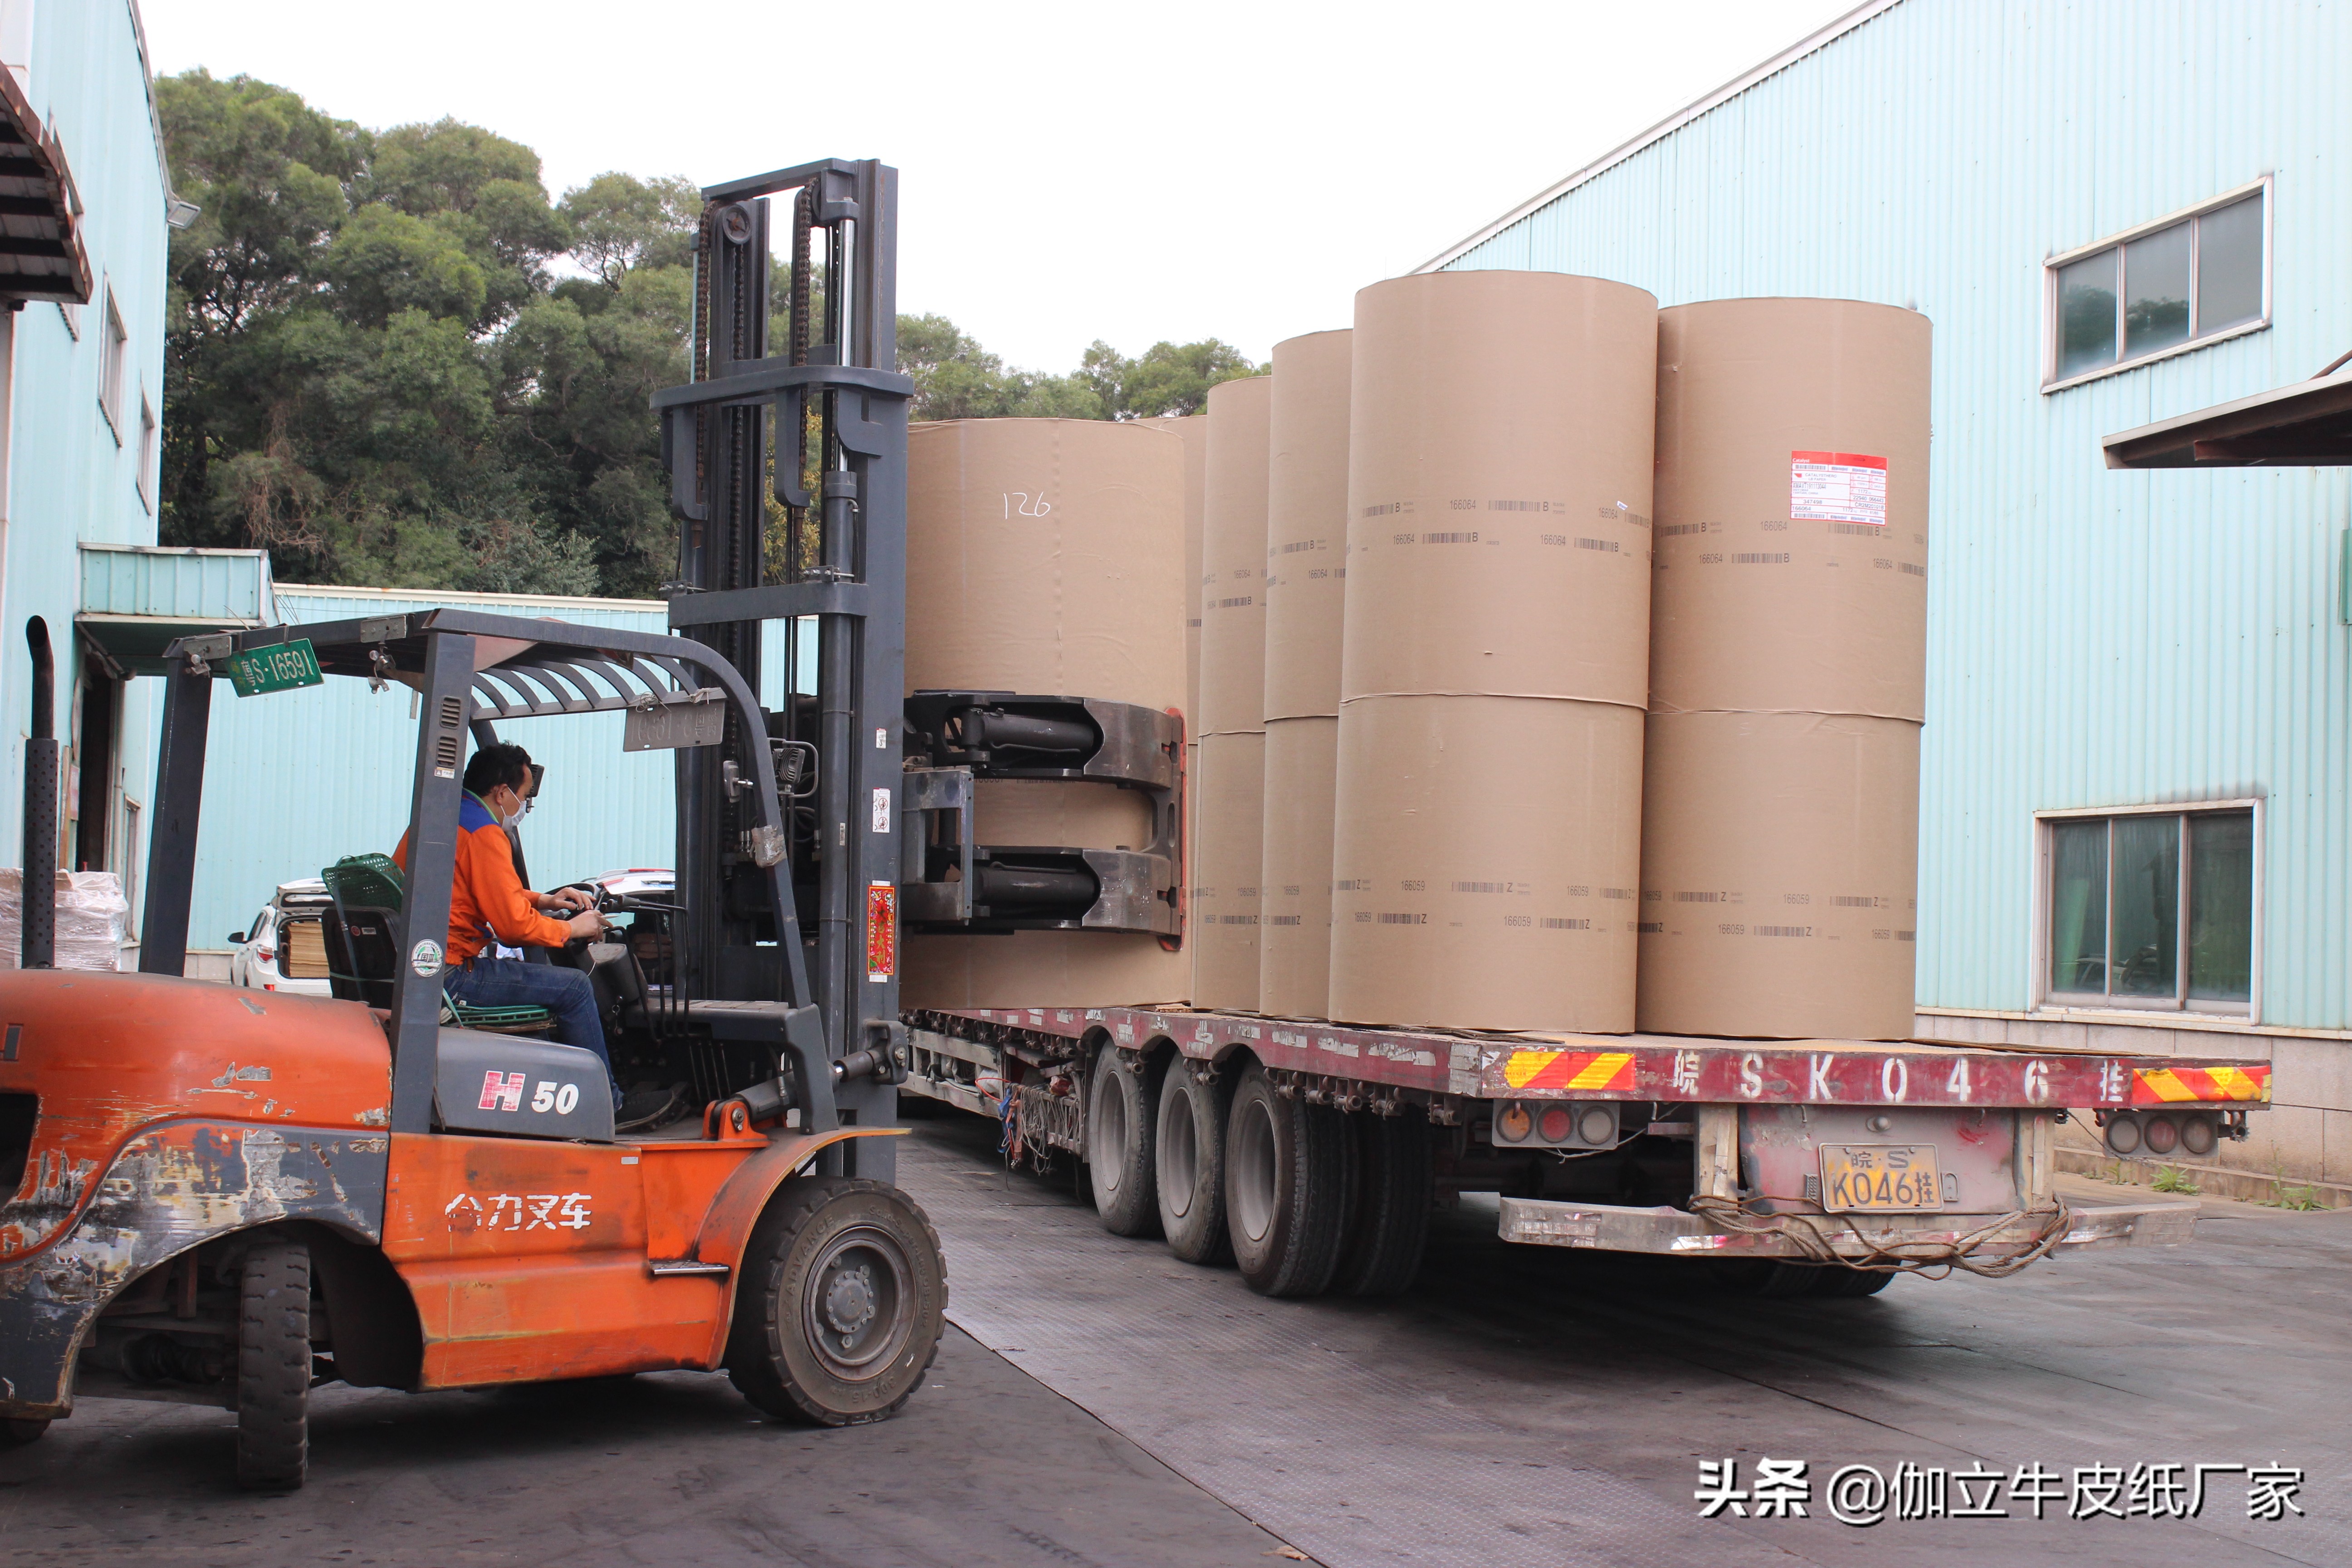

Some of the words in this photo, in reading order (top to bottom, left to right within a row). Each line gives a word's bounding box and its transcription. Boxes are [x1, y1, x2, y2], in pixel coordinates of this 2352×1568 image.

[1003, 491, 1051, 519] 126
[1396, 502, 1400, 512] B
[1450, 500, 1476, 510] 166064
[1543, 501, 1548, 511] B
[1701, 522, 1706, 532] B
[1760, 520, 1788, 531] 166064
[1875, 526, 1880, 536] B
[1310, 540, 1314, 549] B
[1393, 534, 1415, 545] 166064
[1472, 532, 1478, 542] B
[1540, 534, 1566, 546] 166064
[1614, 542, 1619, 552] B
[1699, 553, 1723, 564] 166064
[1784, 553, 1789, 563] B
[1234, 569, 1250, 579] 166064
[1308, 569, 1328, 579] 166064
[1247, 596, 1252, 605] B
[1356, 879, 1360, 890] Z
[1401, 880, 1425, 891] 166059
[1506, 882, 1513, 893] Z
[1567, 885, 1589, 897] 166059
[1720, 892, 1726, 902] Z
[1783, 894, 1810, 905] 166059
[1873, 897, 1878, 907] Z
[1253, 915, 1258, 924] Z
[1296, 915, 1301, 925] Z
[1421, 913, 1427, 924] Z
[1504, 916, 1531, 927] 166059
[1585, 919, 1590, 929] Z
[1658, 922, 1663, 932] Z
[1718, 924, 1744, 935] 166059
[1806, 926, 1812, 937] Z
[531, 1080, 580, 1115] 50
[1833, 1171, 1934, 1205] K046挂
[445, 1192, 593, 1232] 合力叉车
[785, 1212, 835, 1297] ADVANCE
